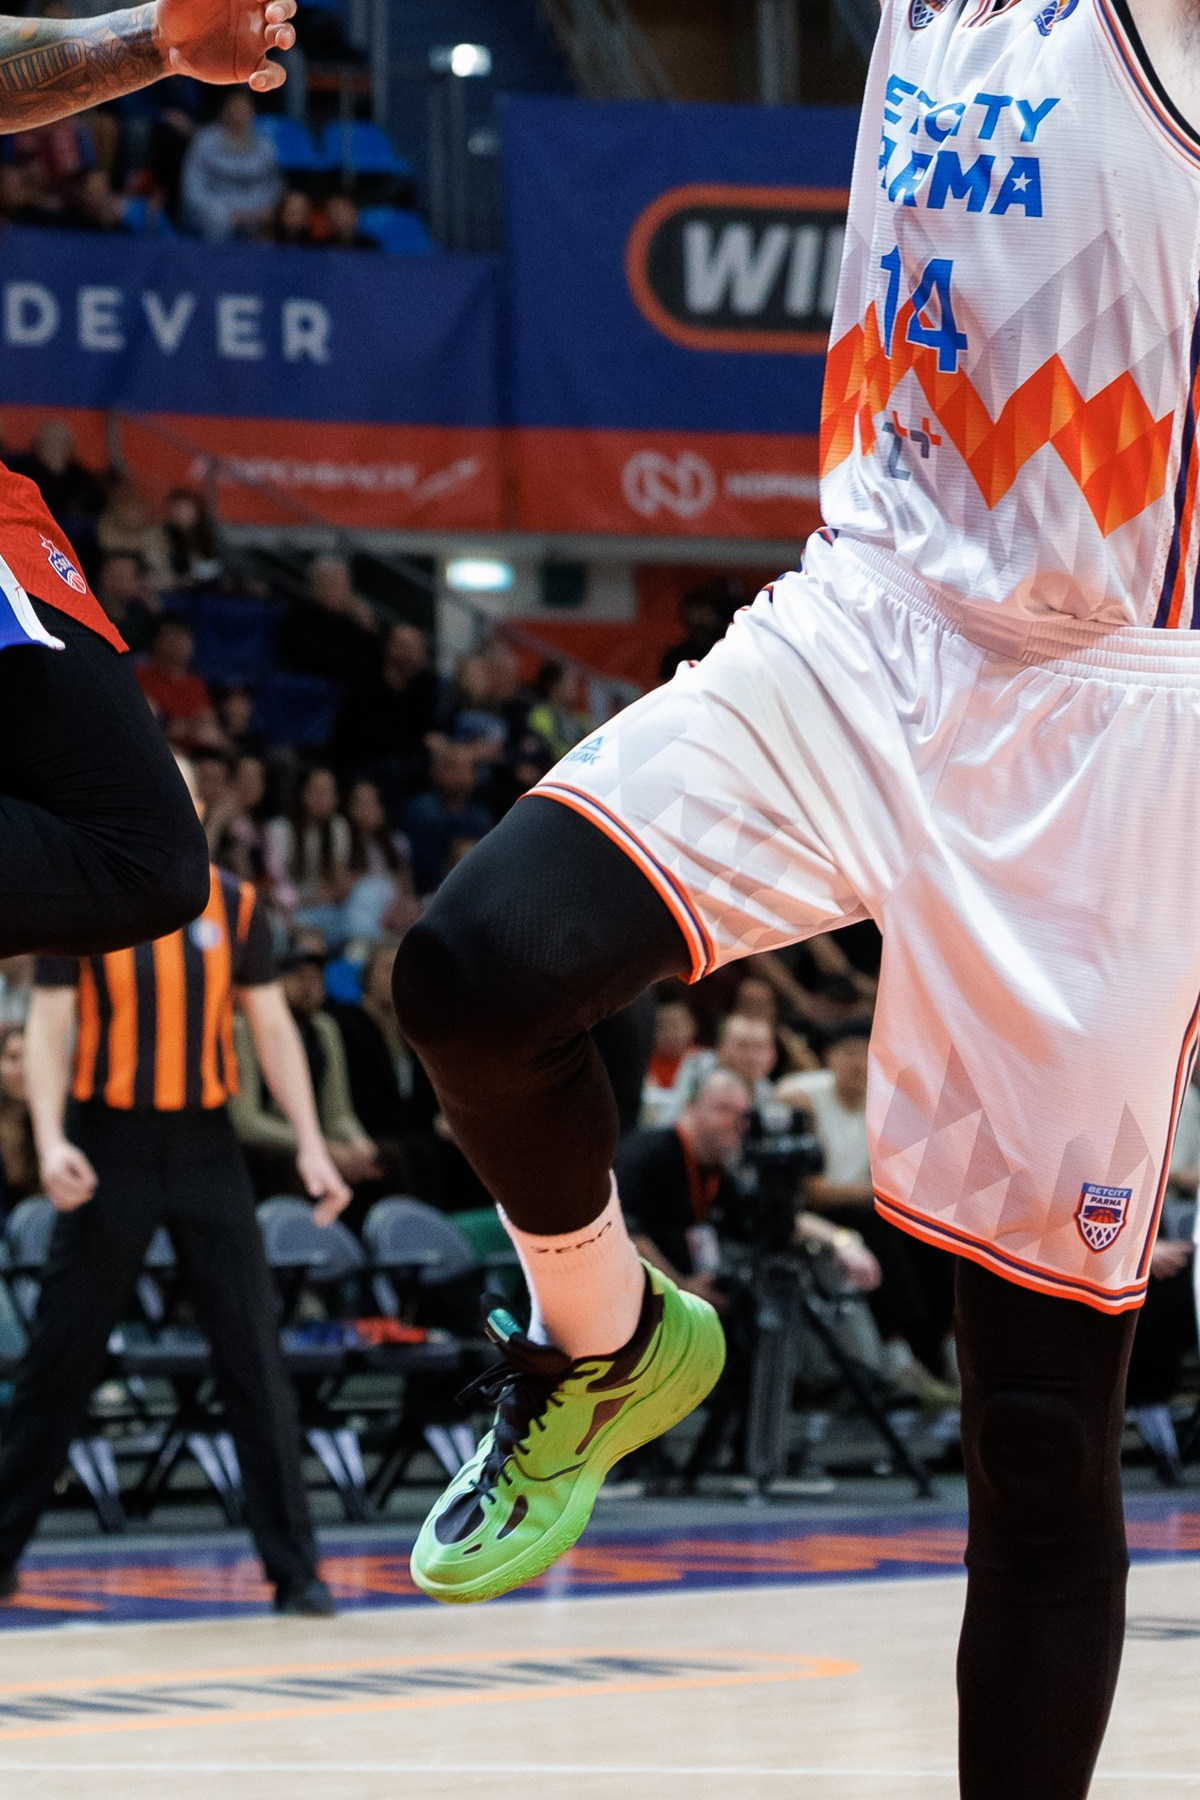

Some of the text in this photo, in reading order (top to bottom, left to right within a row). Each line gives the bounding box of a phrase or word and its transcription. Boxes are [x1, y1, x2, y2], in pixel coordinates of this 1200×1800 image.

[880, 245, 968, 374] 14
[1087, 1185, 1129, 1197] BETCITY
[1090, 1196, 1122, 1206] PARMA
